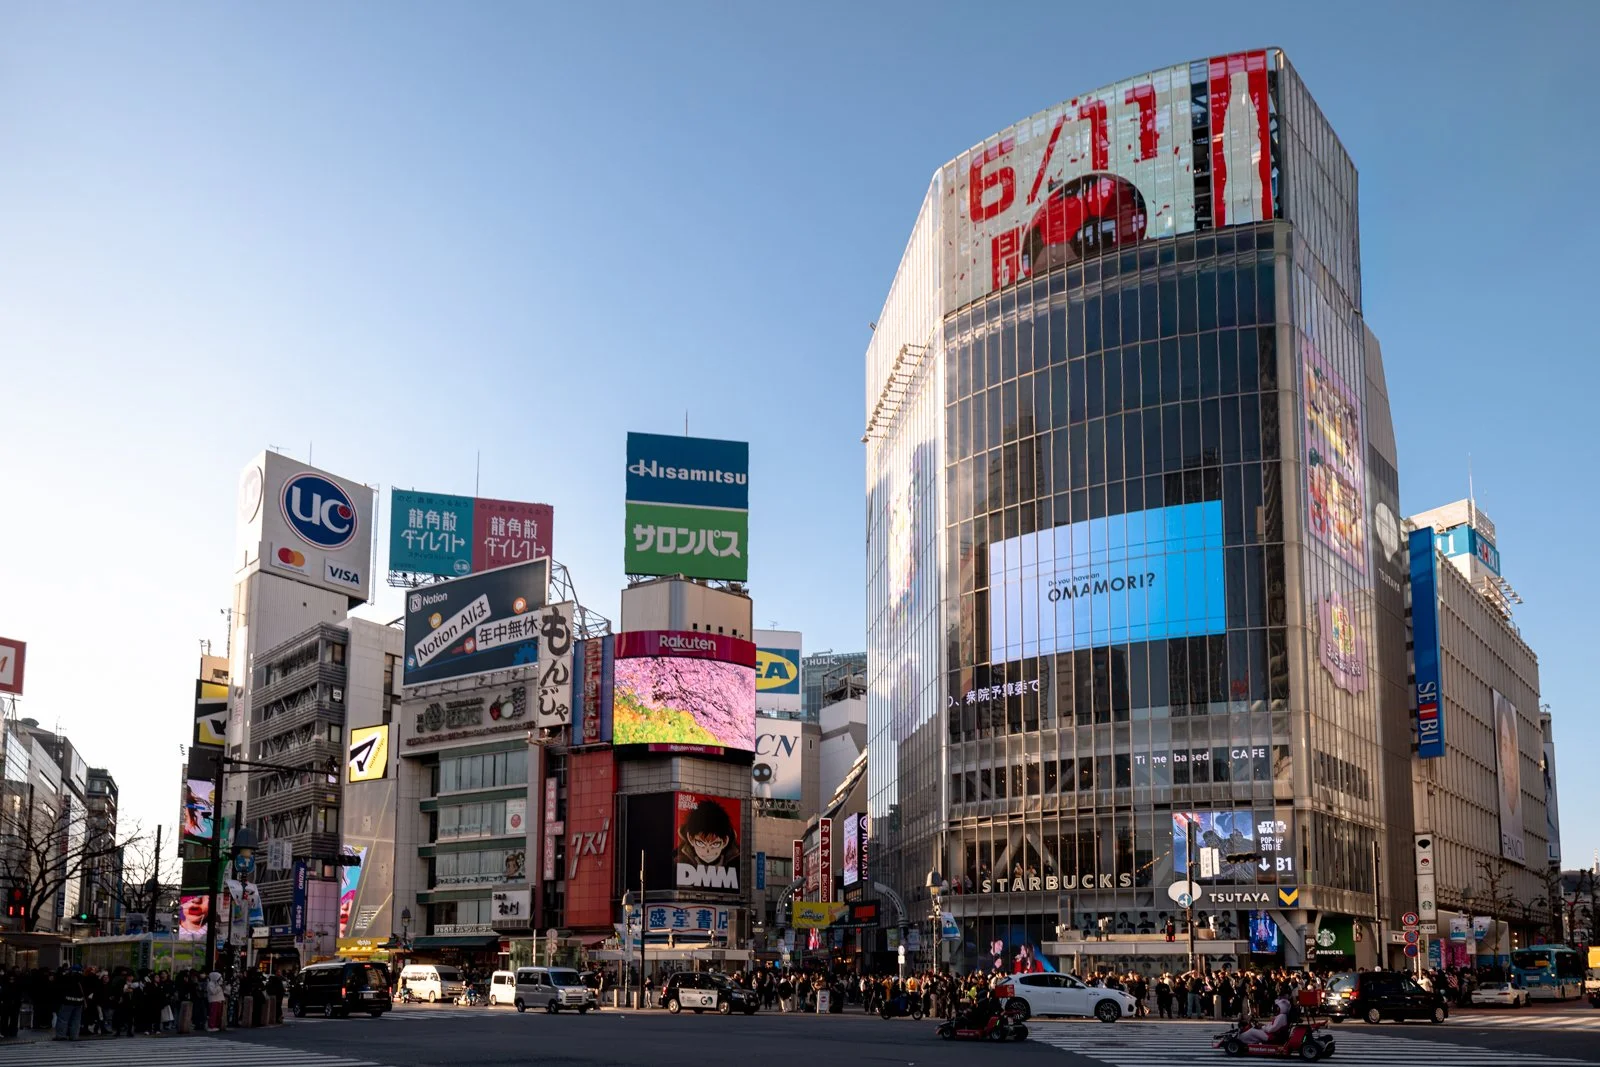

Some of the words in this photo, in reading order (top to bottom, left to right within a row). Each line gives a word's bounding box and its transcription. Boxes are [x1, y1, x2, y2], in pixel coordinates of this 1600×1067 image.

[628, 459, 746, 485] Hisamitsu
[408, 507, 457, 531] 龍角散
[491, 516, 538, 539] 龍角散
[401, 529, 465, 553] ダイレクト
[484, 537, 546, 559] ダイレクト
[633, 523, 741, 558] サロンパス
[328, 565, 360, 584] VISA
[1058, 577, 1070, 587] you
[1378, 567, 1401, 593] TSUTAYA
[422, 592, 448, 606] Notion
[1048, 572, 1155, 602] OMAMORI?
[478, 615, 538, 645] 年中無休
[417, 626, 458, 661] Notion
[659, 635, 717, 651] Rakuten
[539, 606, 570, 722] もんじゃ
[1417, 681, 1439, 746] SEIBU
[1135, 755, 1168, 765] Time
[1173, 752, 1210, 763] based
[1231, 748, 1265, 760] CAFE
[820, 824, 830, 869] カラオケ
[676, 863, 739, 889] DMM
[1276, 857, 1292, 871] B1
[982, 872, 1132, 893] STARBUCKS
[1209, 892, 1270, 903] TSUTAYA
[700, 996, 713, 1006] GO
